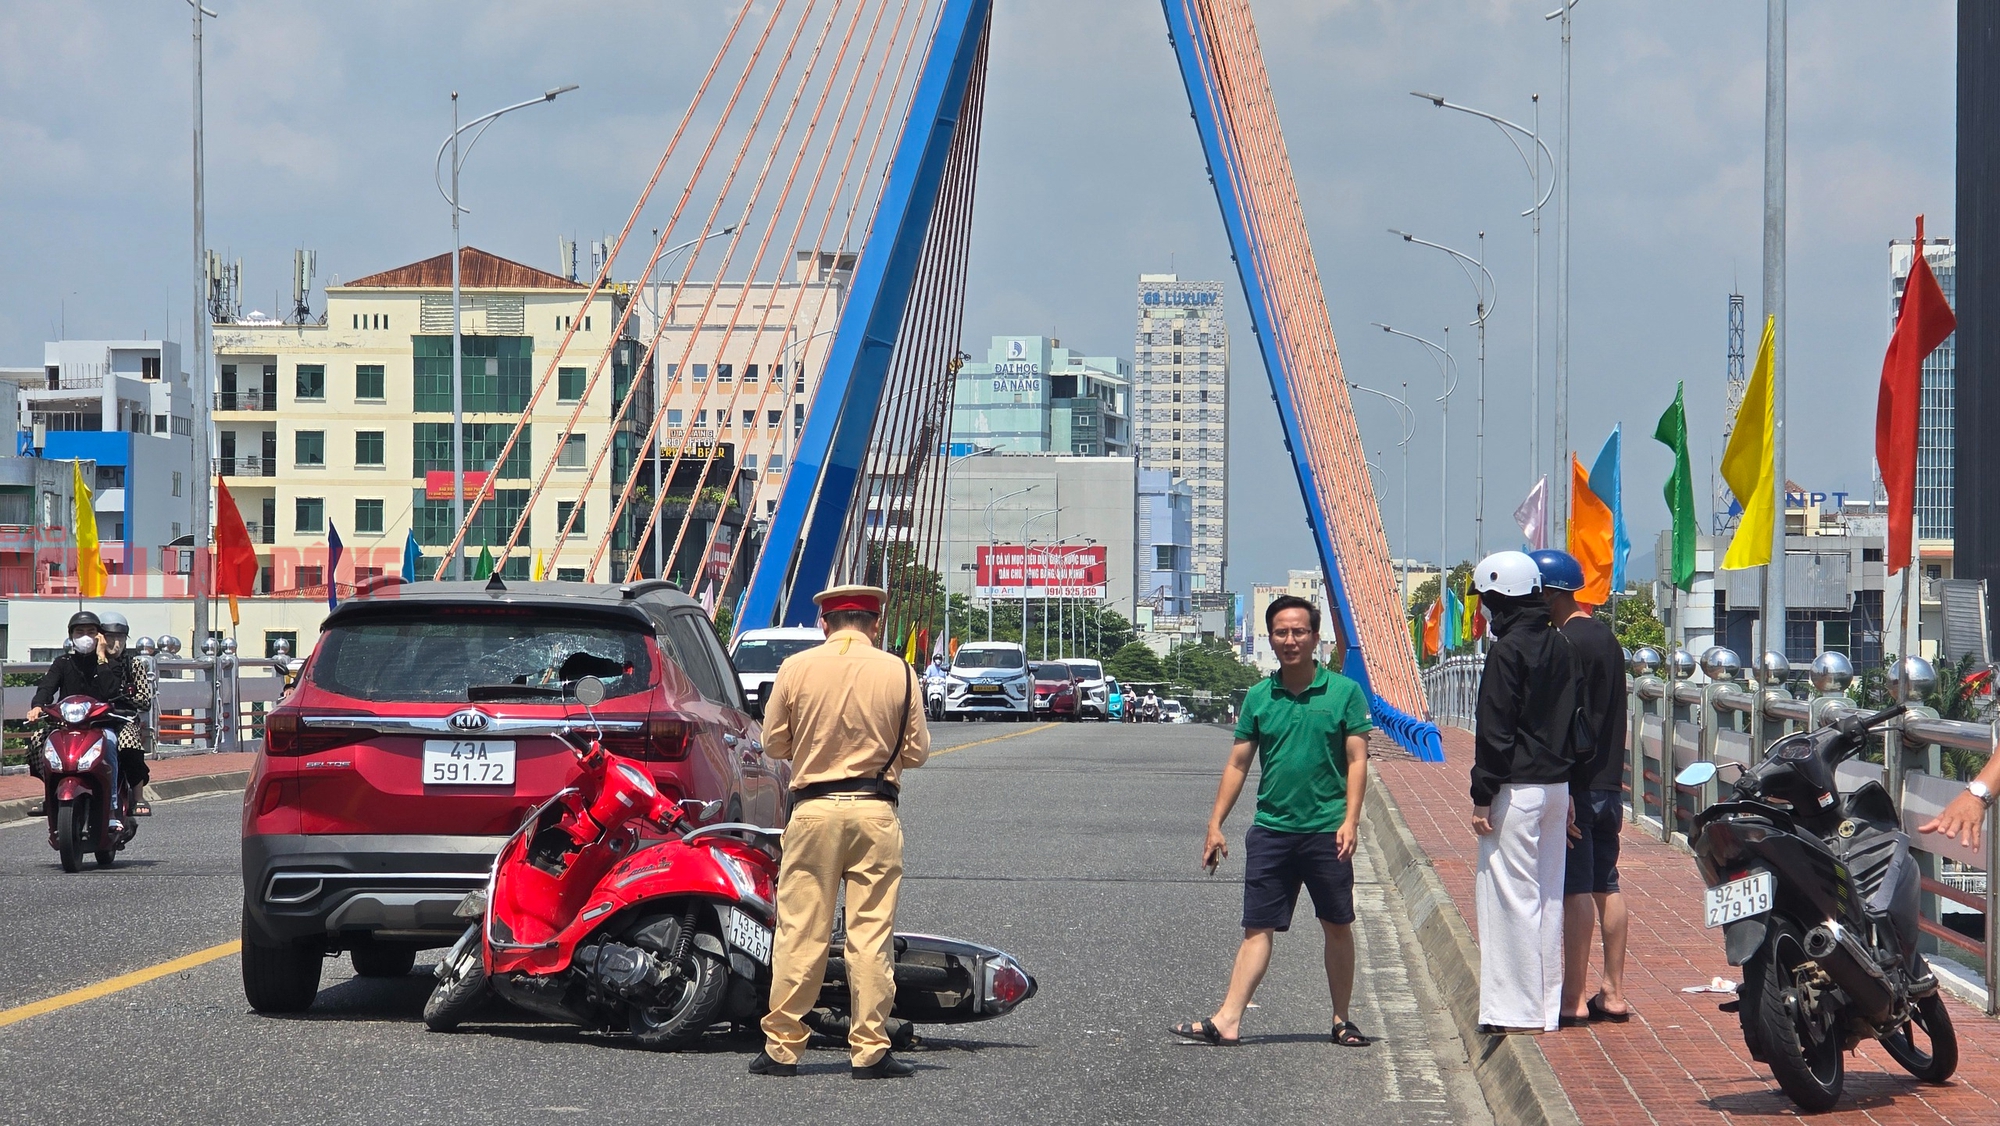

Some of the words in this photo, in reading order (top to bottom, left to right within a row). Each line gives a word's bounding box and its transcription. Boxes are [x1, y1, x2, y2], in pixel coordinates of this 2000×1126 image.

[1164, 291, 1218, 306] LUXURY
[1786, 492, 1849, 508] NPT
[455, 715, 482, 726] KIA
[450, 742, 489, 761] 43A
[433, 763, 504, 781] 591.72
[1715, 878, 1760, 904] 92-H1
[1709, 893, 1768, 926] 279.19
[738, 914, 766, 942] 43-E1
[732, 928, 769, 962] 152.67
